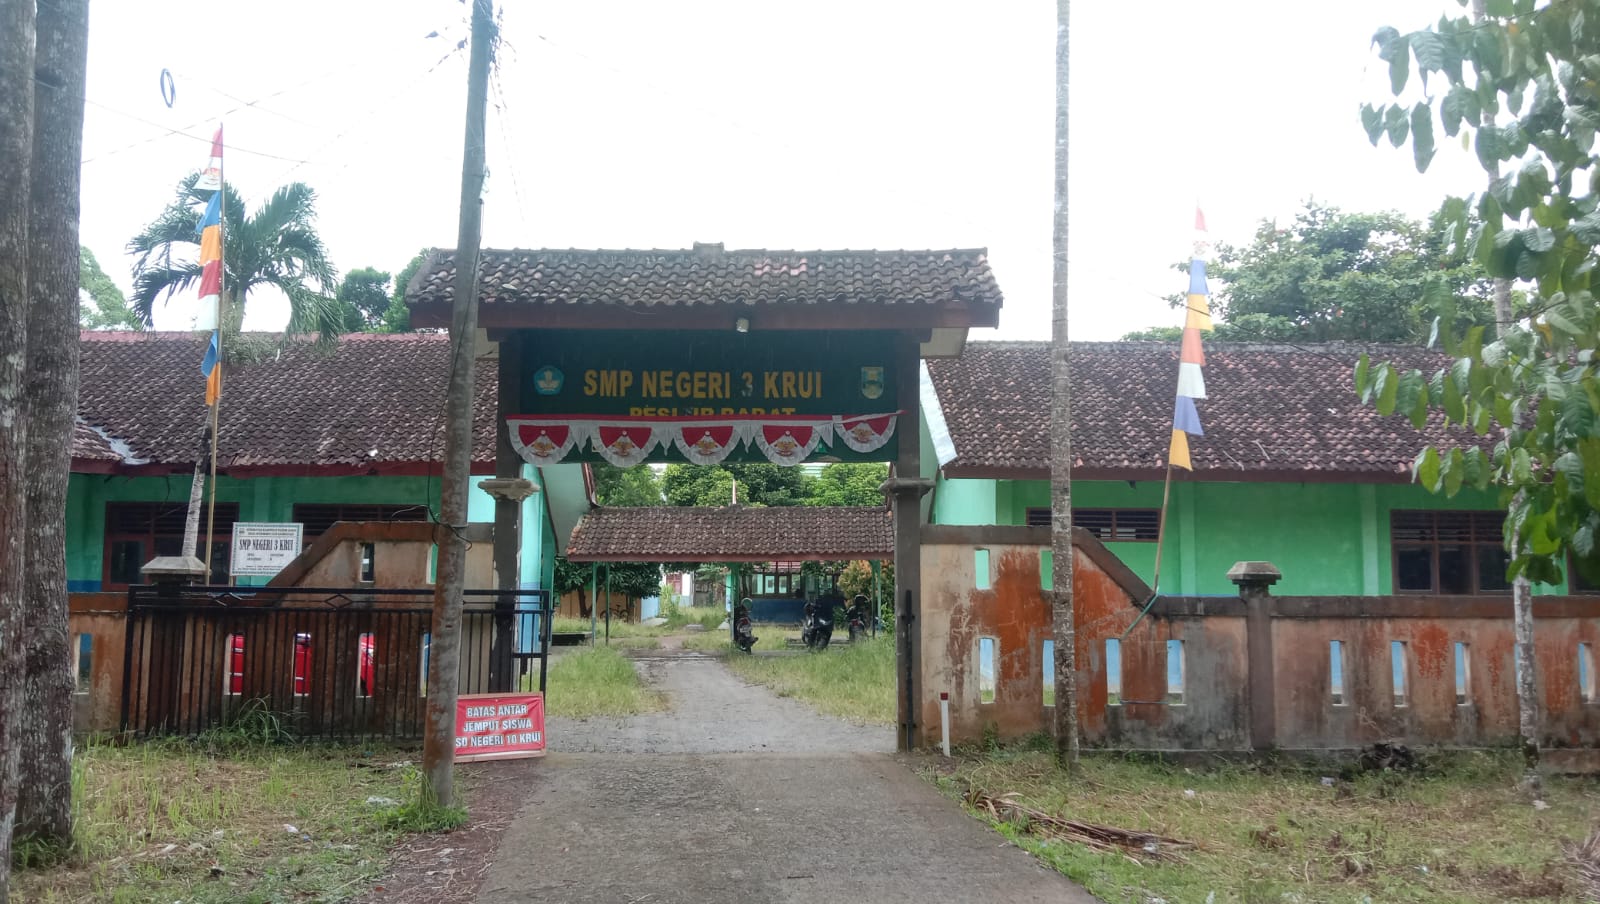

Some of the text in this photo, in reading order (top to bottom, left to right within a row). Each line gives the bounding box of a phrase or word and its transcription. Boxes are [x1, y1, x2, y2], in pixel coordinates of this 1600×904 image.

[583, 369, 823, 399] SMP NEGERI 3 KRUI
[239, 539, 251, 551] SMP
[253, 539, 272, 551] NEGERI
[280, 539, 294, 551] KRUI
[467, 704, 528, 718] BATAS ANTAR
[463, 719, 533, 732] JEMPUT SISWA
[455, 732, 542, 747] SD NEGERI 10 KRUI
